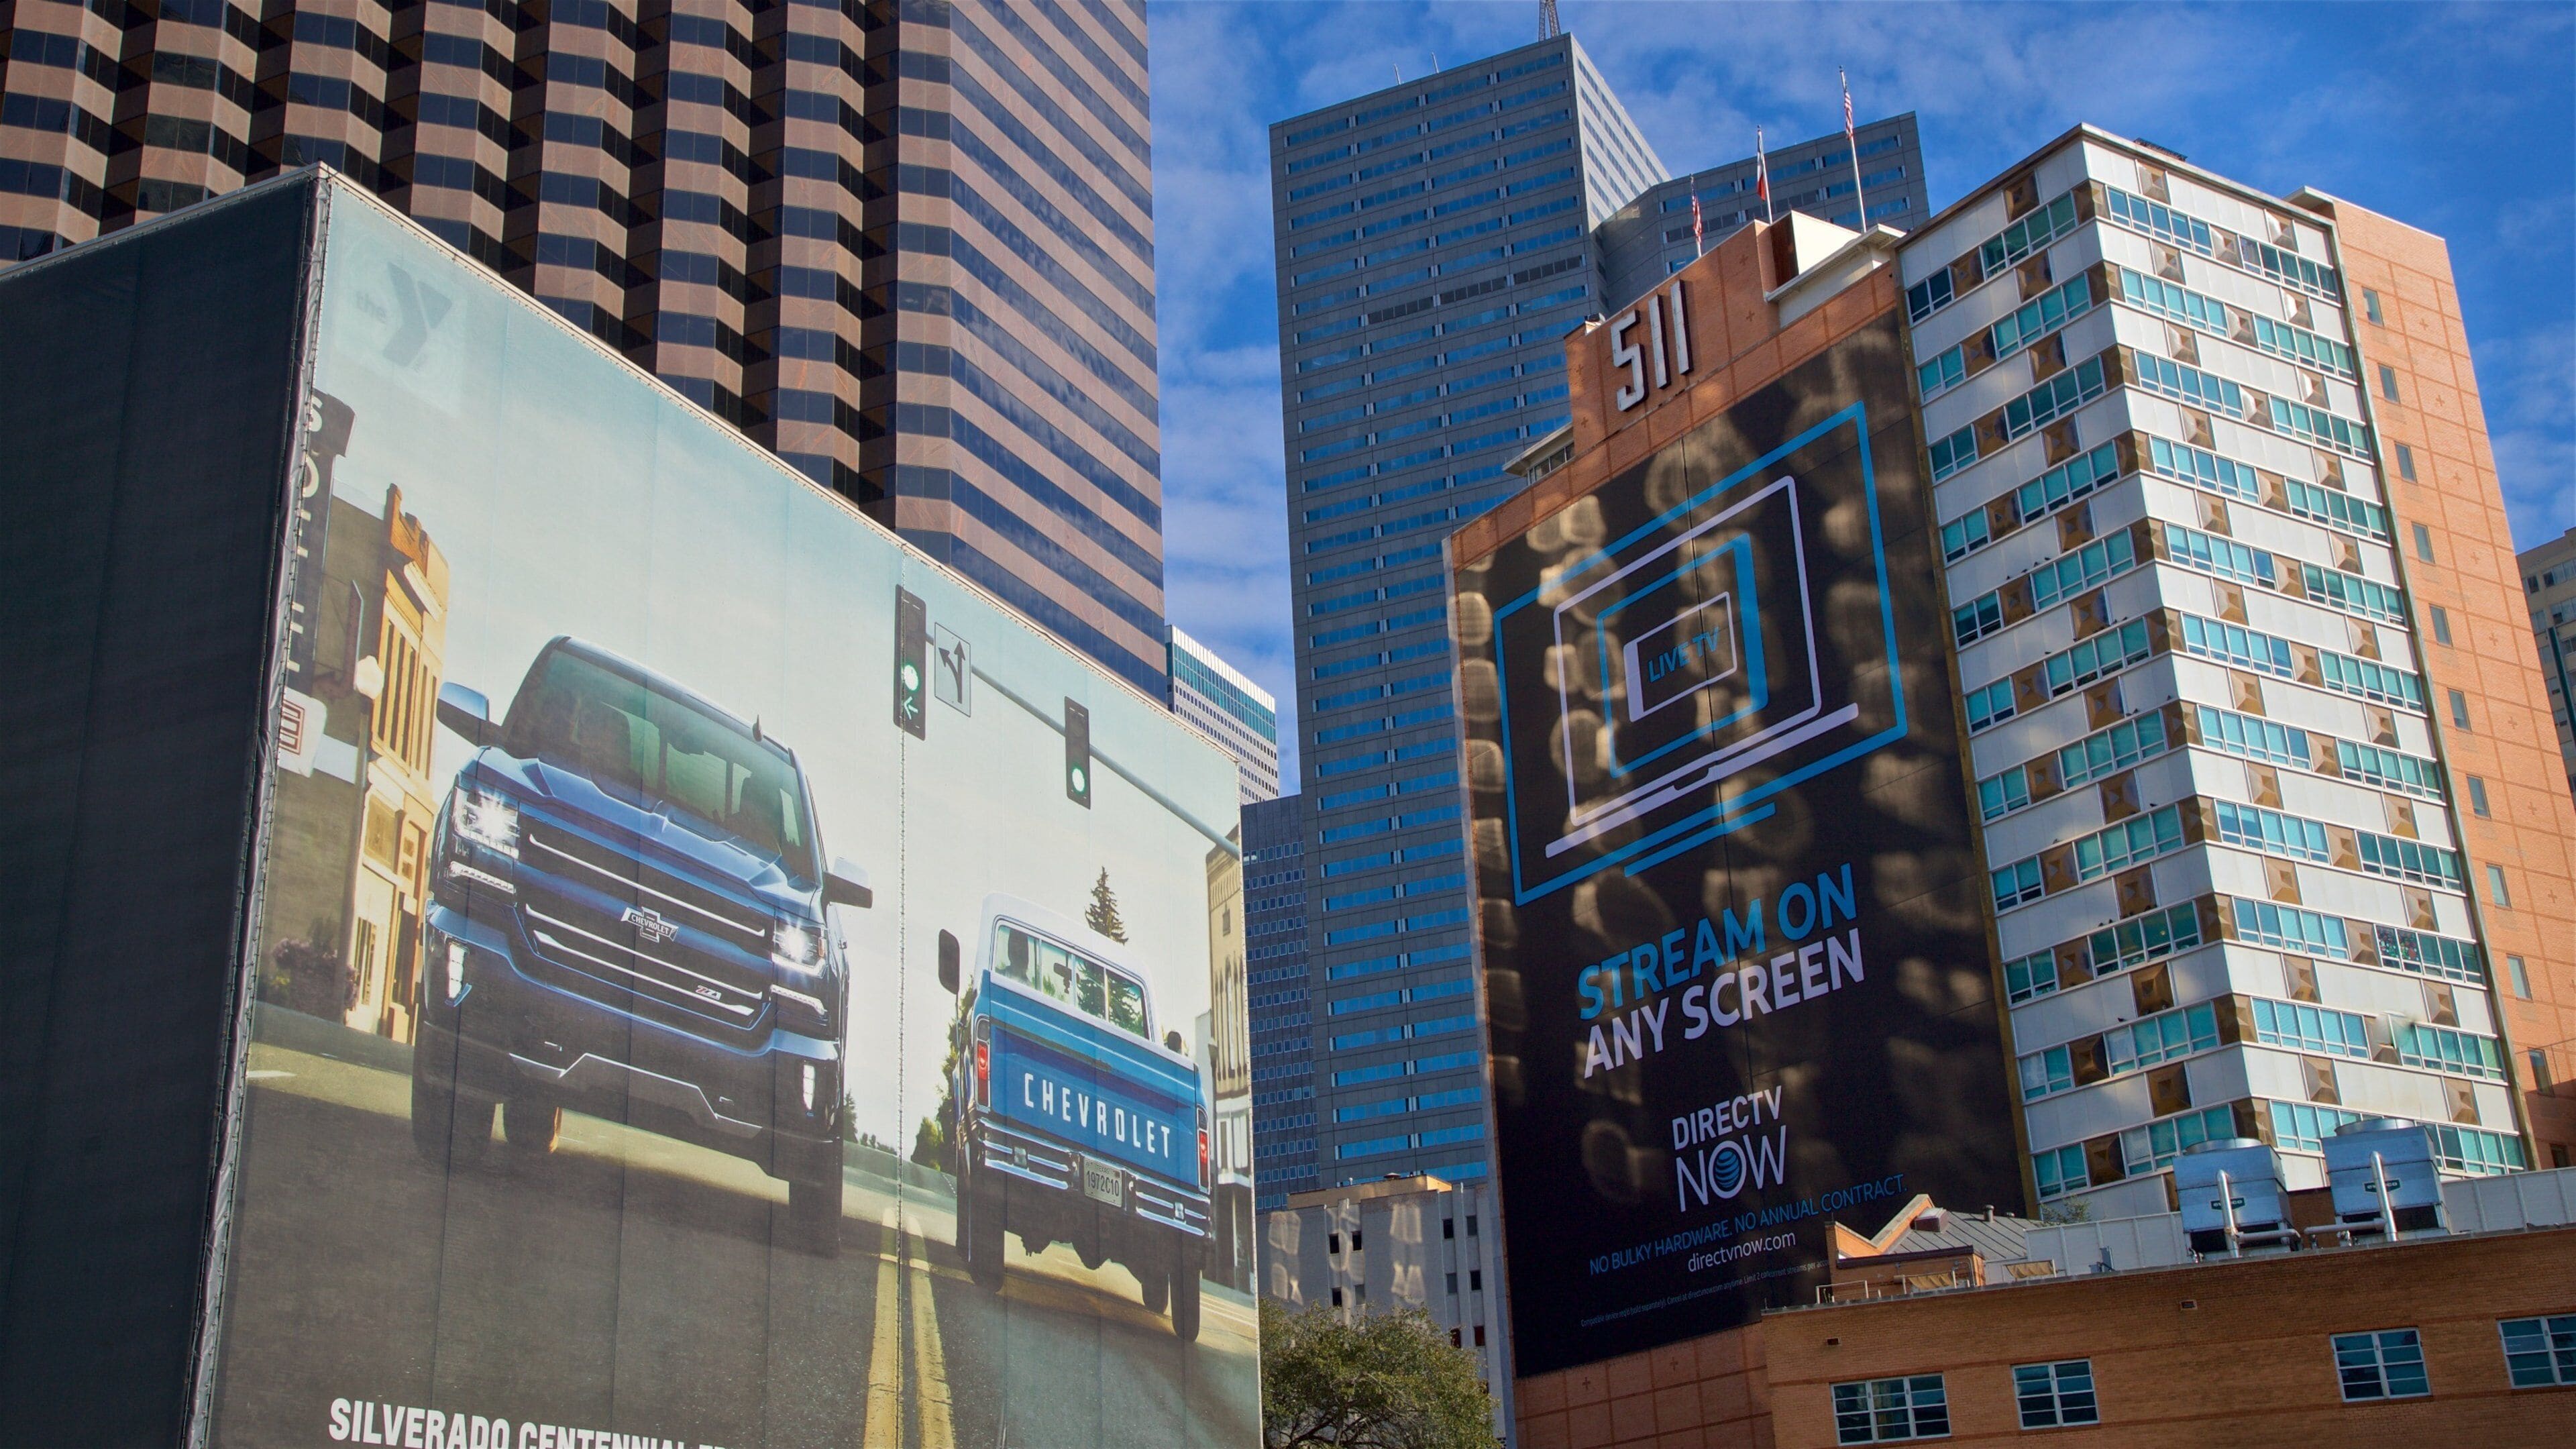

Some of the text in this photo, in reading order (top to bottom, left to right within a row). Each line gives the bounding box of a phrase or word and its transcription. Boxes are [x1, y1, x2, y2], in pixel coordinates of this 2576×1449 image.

[1611, 279, 1693, 412] 511
[1648, 627, 1719, 683] LIVE TV
[631, 913, 669, 935] CHEVROLET
[1578, 863, 1857, 1020] STREAM ON
[1584, 928, 1864, 1079] ANY SCREEN
[1024, 1073, 1170, 1159] CHEVROLET
[1672, 1085, 1782, 1150] DIRECTV
[1086, 1170, 1120, 1197] 1972C10
[1676, 1125, 1786, 1213] NOW
[1589, 1174, 1908, 1275] NO BULKY HARDWARE. NO ANNUAL CONTRACT.
[1688, 1232, 1796, 1273] directvnow.com
[1807, 1263, 1815, 1273] per
[328, 1397, 511, 1449] SILVERADO
